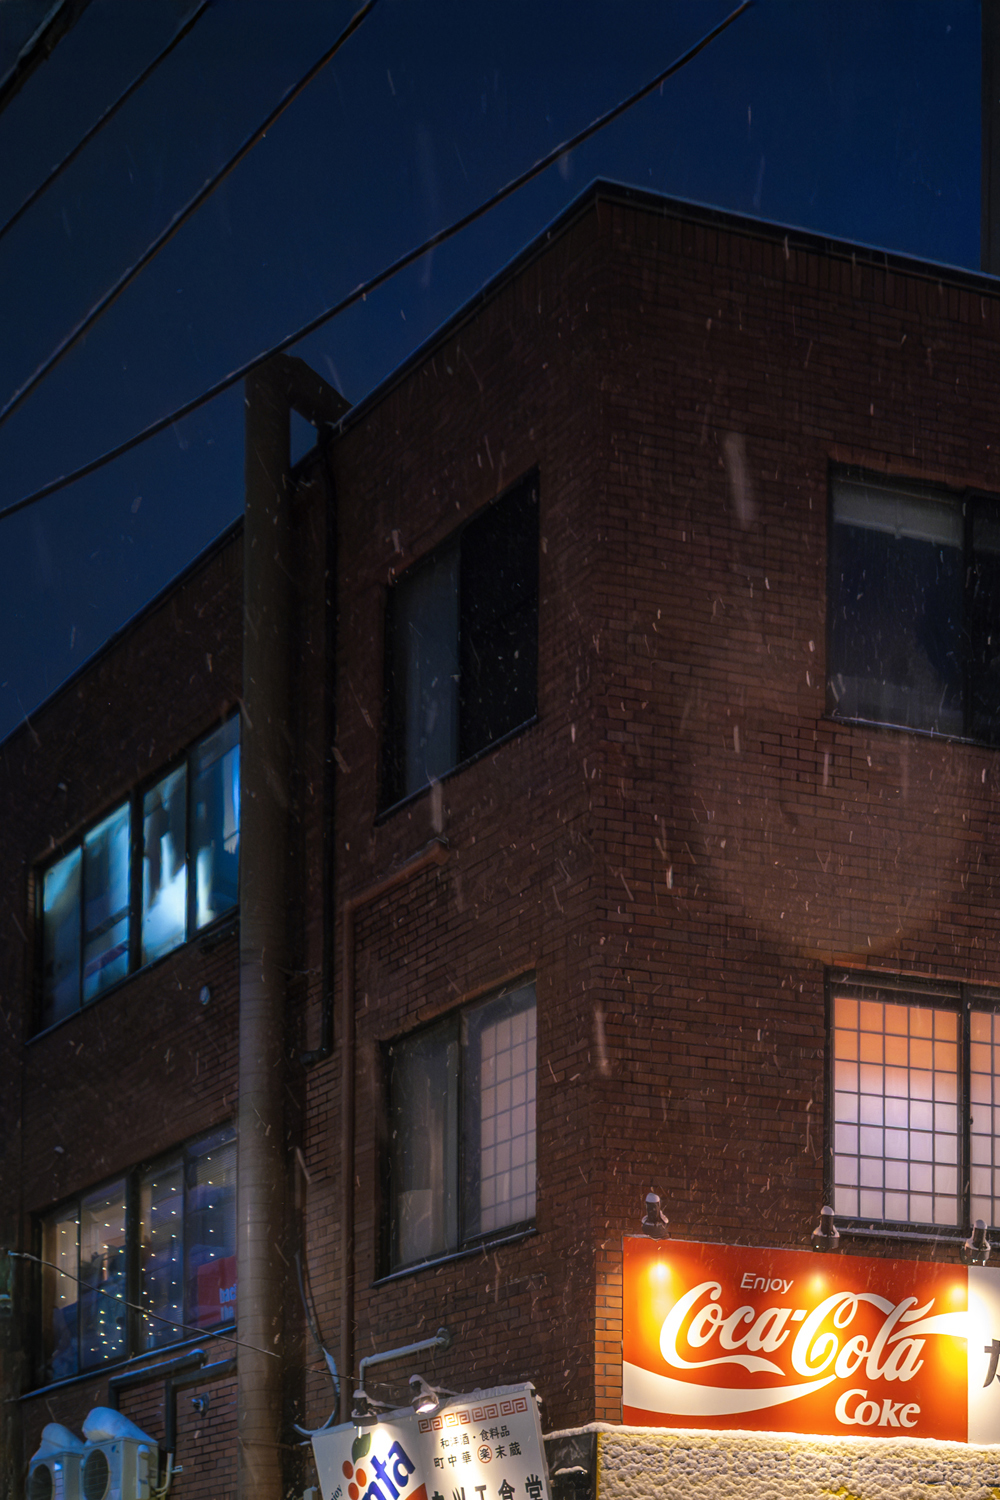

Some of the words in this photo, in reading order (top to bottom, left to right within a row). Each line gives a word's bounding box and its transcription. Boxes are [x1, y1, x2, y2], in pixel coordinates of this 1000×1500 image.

[740, 1272, 795, 1296] Enjoy
[659, 1279, 938, 1384] Coca-Cola
[834, 1387, 922, 1429] Coke
